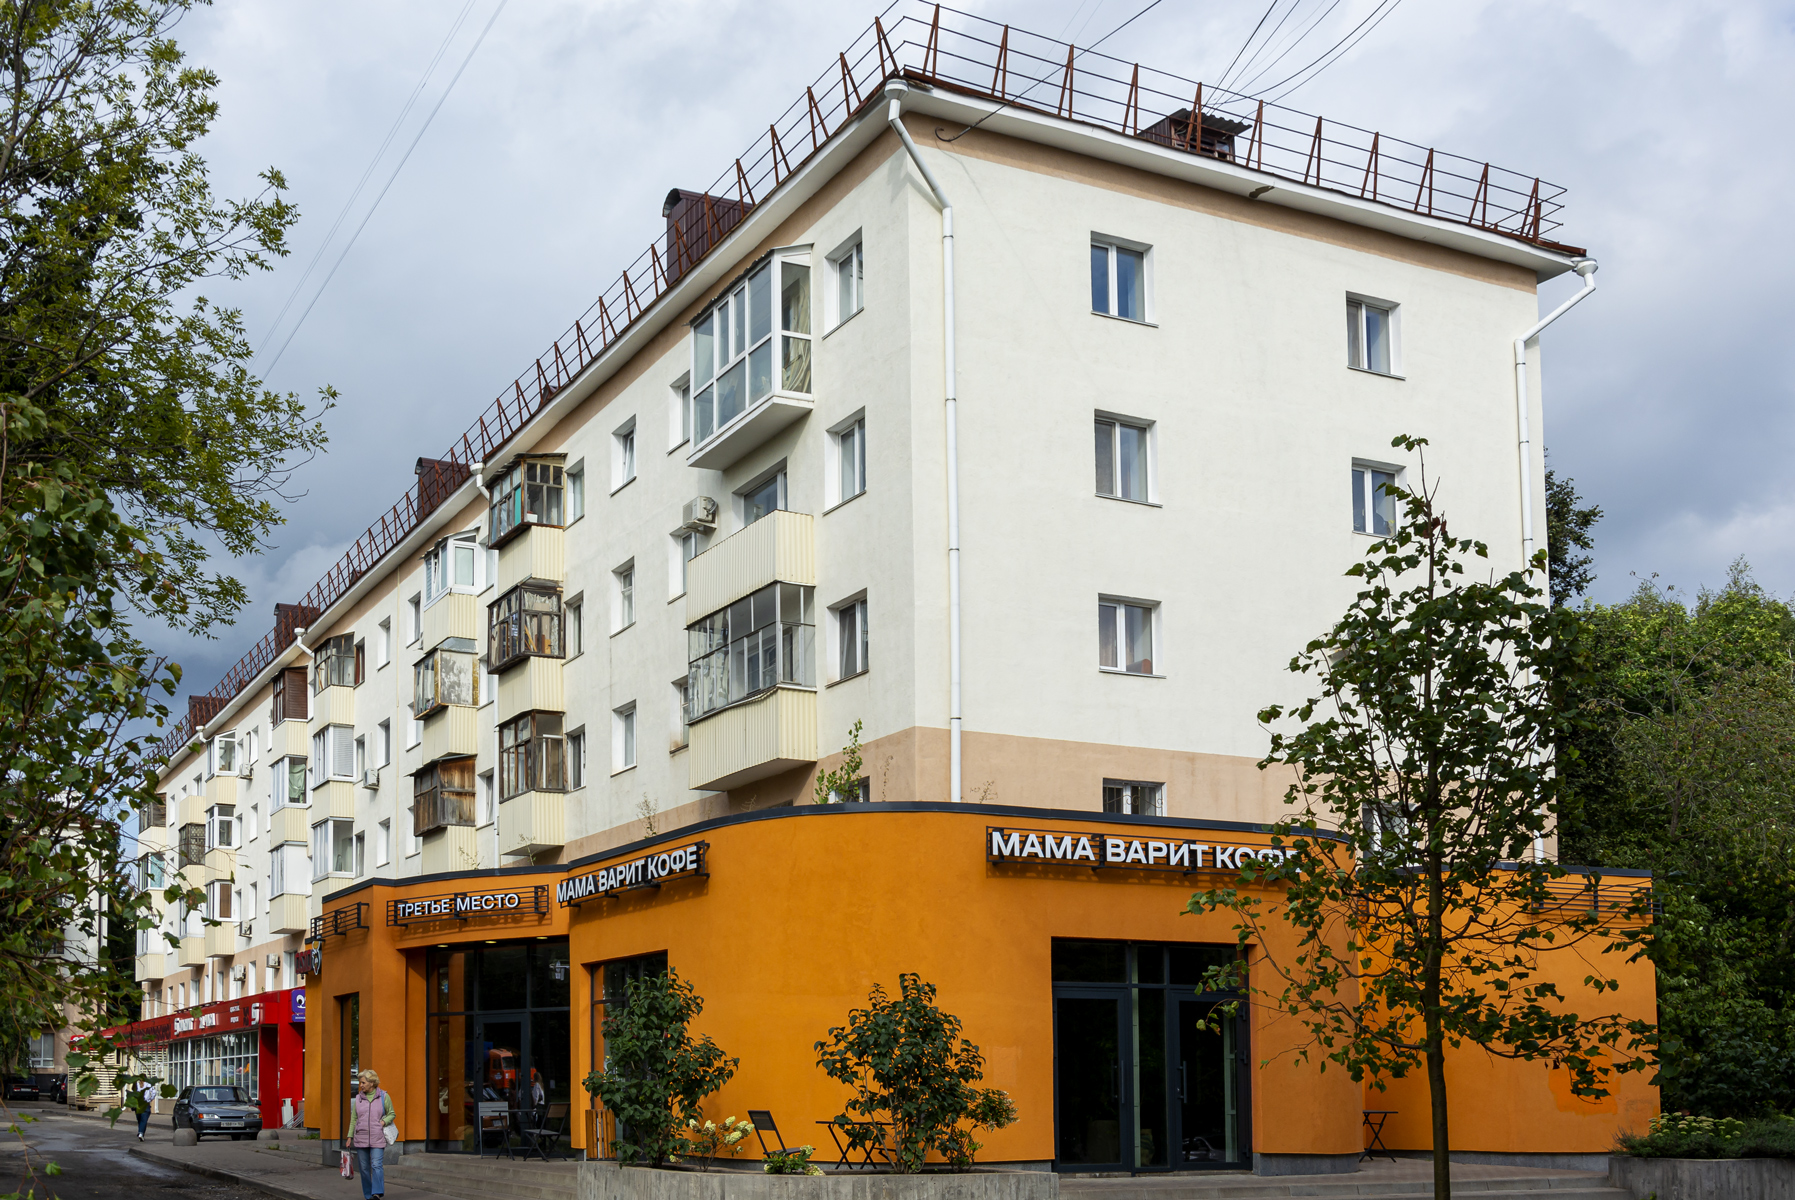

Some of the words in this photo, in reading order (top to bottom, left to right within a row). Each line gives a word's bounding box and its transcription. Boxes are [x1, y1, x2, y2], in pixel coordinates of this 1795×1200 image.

[992, 831, 1096, 861] МАМА
[1106, 838, 1209, 868] ВАРИТ
[556, 874, 597, 903] МАМА
[598, 858, 645, 892] ВАРИТ
[647, 845, 698, 880] КОФЕ
[397, 898, 450, 917] ТРЕТЬЕ
[456, 892, 520, 912] МЕСТО
